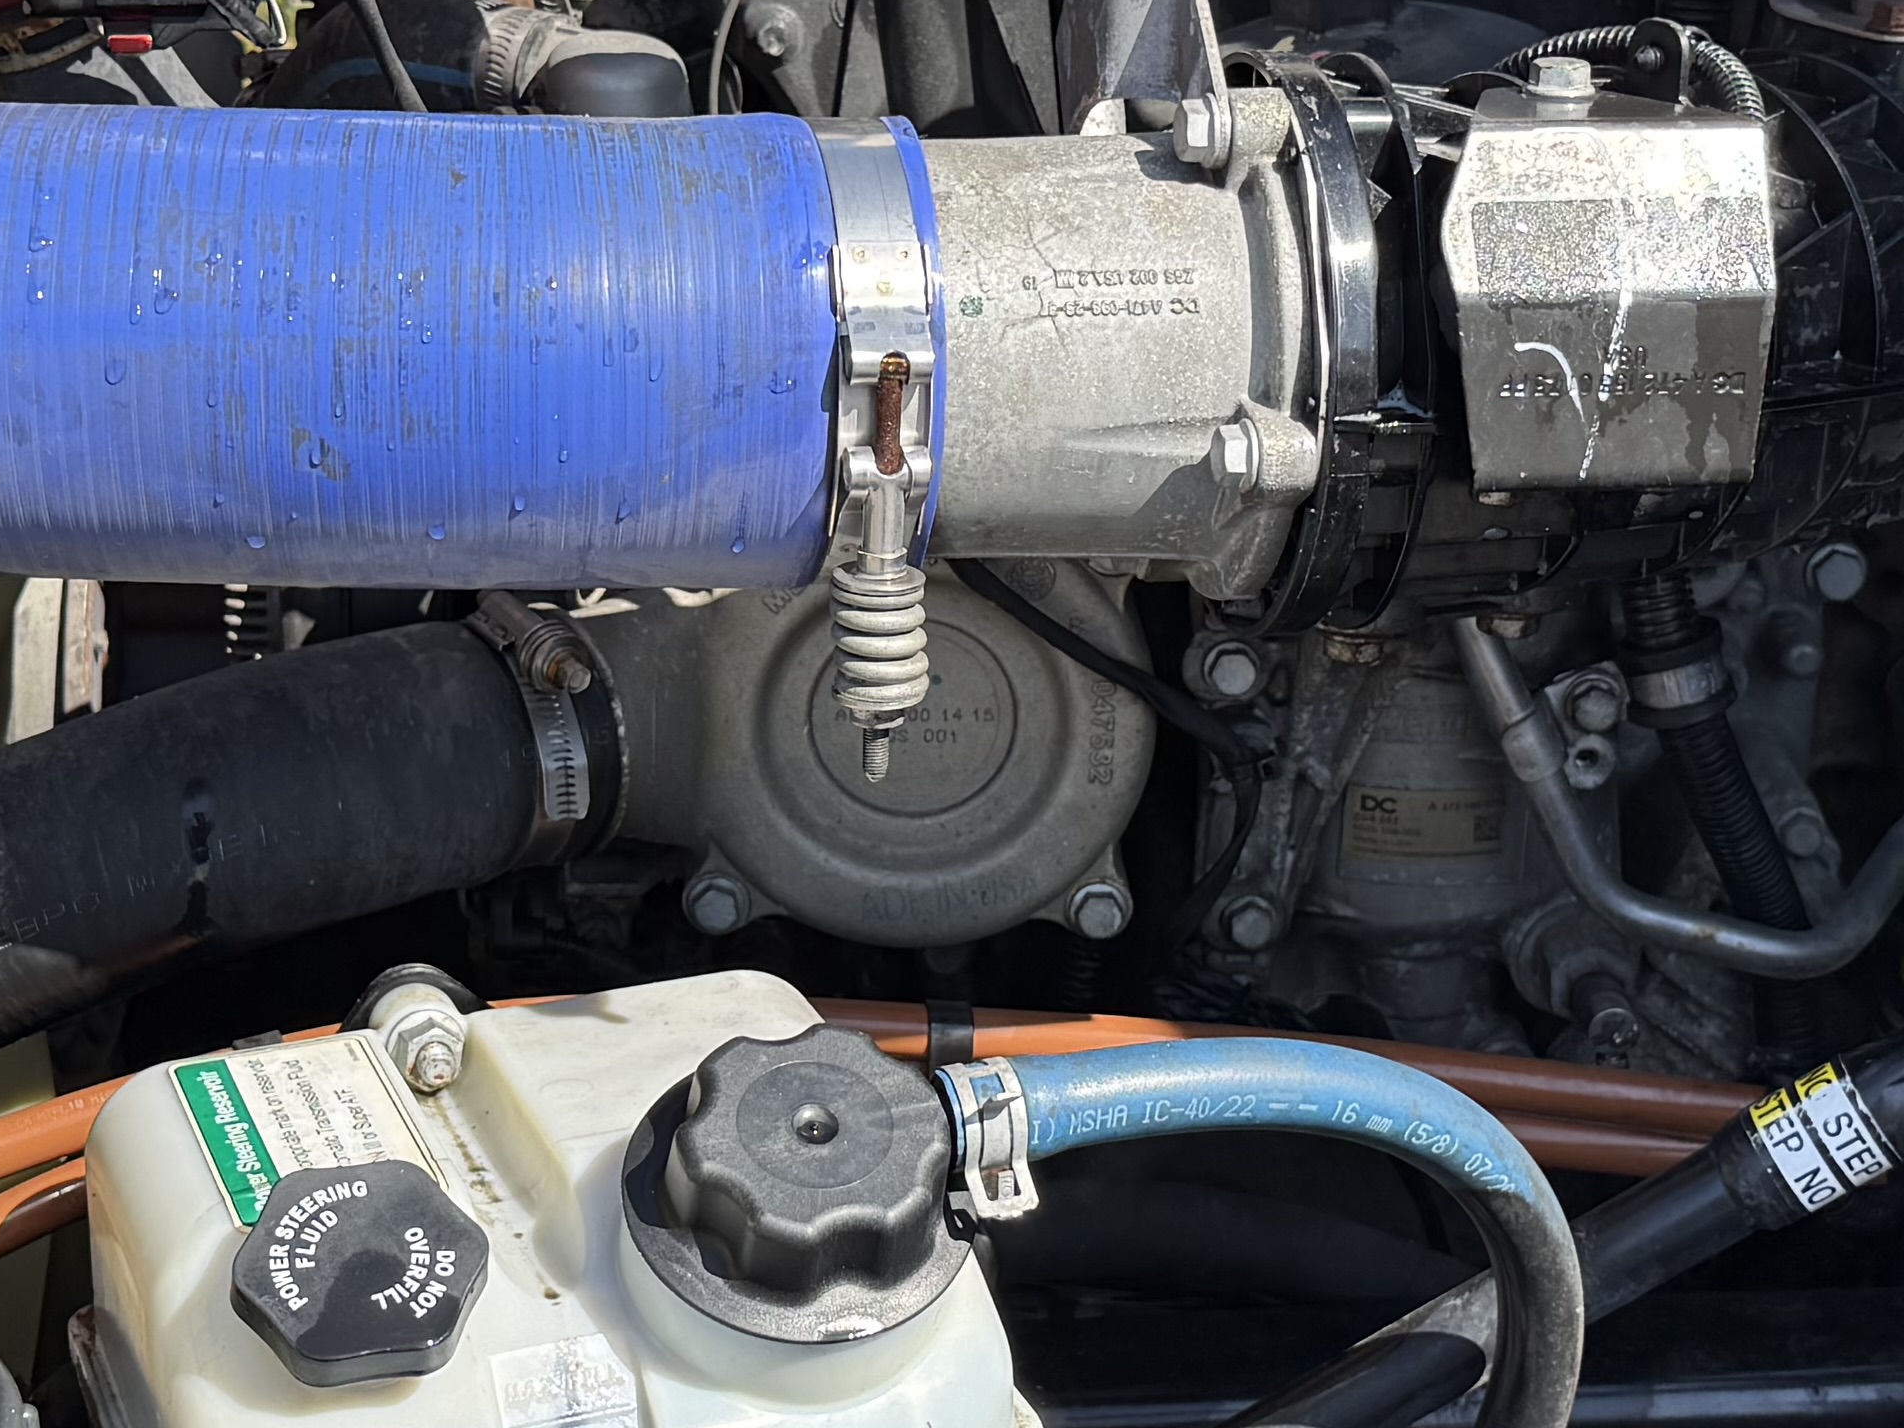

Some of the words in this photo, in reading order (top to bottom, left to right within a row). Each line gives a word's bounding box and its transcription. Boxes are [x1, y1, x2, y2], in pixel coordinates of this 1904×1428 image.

[1168, 297, 1200, 316] DC
[1359, 793, 1398, 813] DC
[280, 1059, 308, 1080] Fluid
[199, 1069, 242, 1126] Reservoir
[292, 1081, 335, 1134] Transmission
[342, 1102, 375, 1130] Super
[223, 1118, 262, 1174] Steering
[1069, 1106, 1128, 1135] MSHA
[1142, 1096, 1255, 1123] IC-40/22
[1330, 1100, 1358, 1124] 16
[1404, 1120, 1459, 1157] (5/8)
[1823, 1112, 1884, 1178] STEP
[274, 1179, 368, 1241] STEERING
[1793, 1166, 1837, 1205] NO
[294, 1209, 339, 1270] FLUID
[435, 1249, 456, 1277] DO
[269, 1243, 309, 1312] POWER
[370, 1226, 431, 1311] OVERFILL
[409, 1280, 447, 1320] NOT
